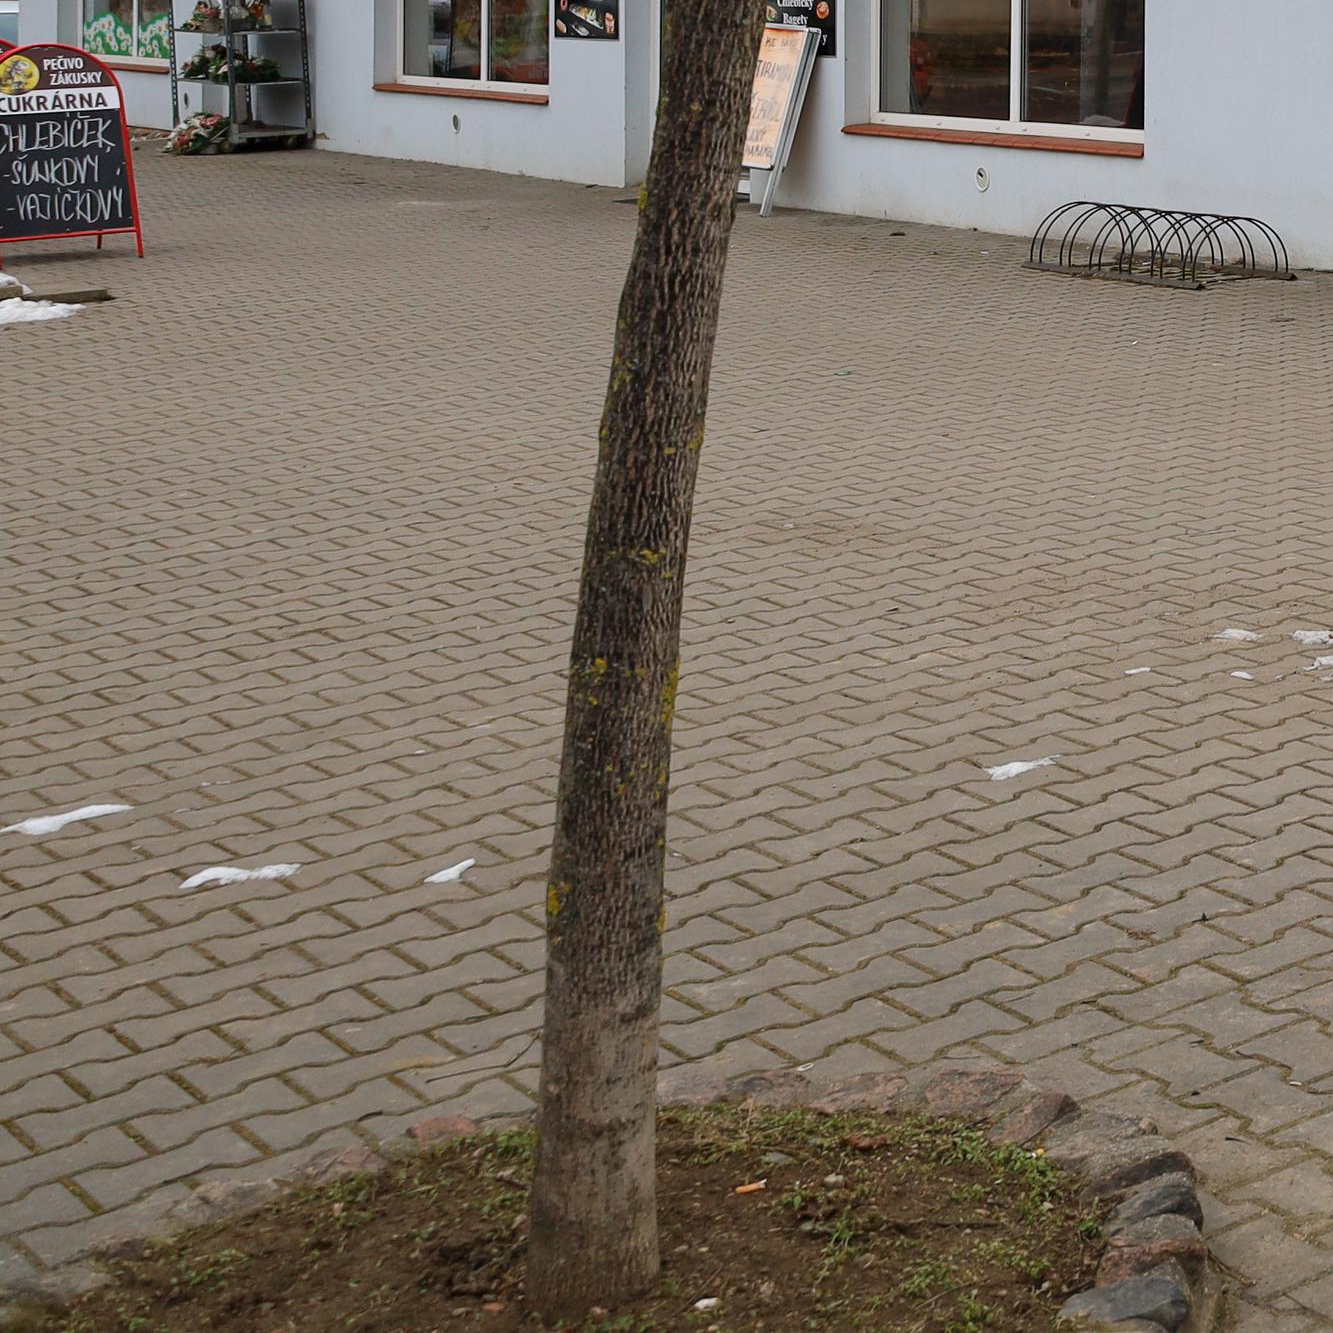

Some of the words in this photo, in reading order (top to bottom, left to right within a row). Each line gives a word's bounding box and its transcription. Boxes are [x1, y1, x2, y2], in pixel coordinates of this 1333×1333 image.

[783, 13, 808, 26] Bagety
[43, 55, 84, 71] PEČIVO
[50, 70, 102, 85] ZÁKUSKY
